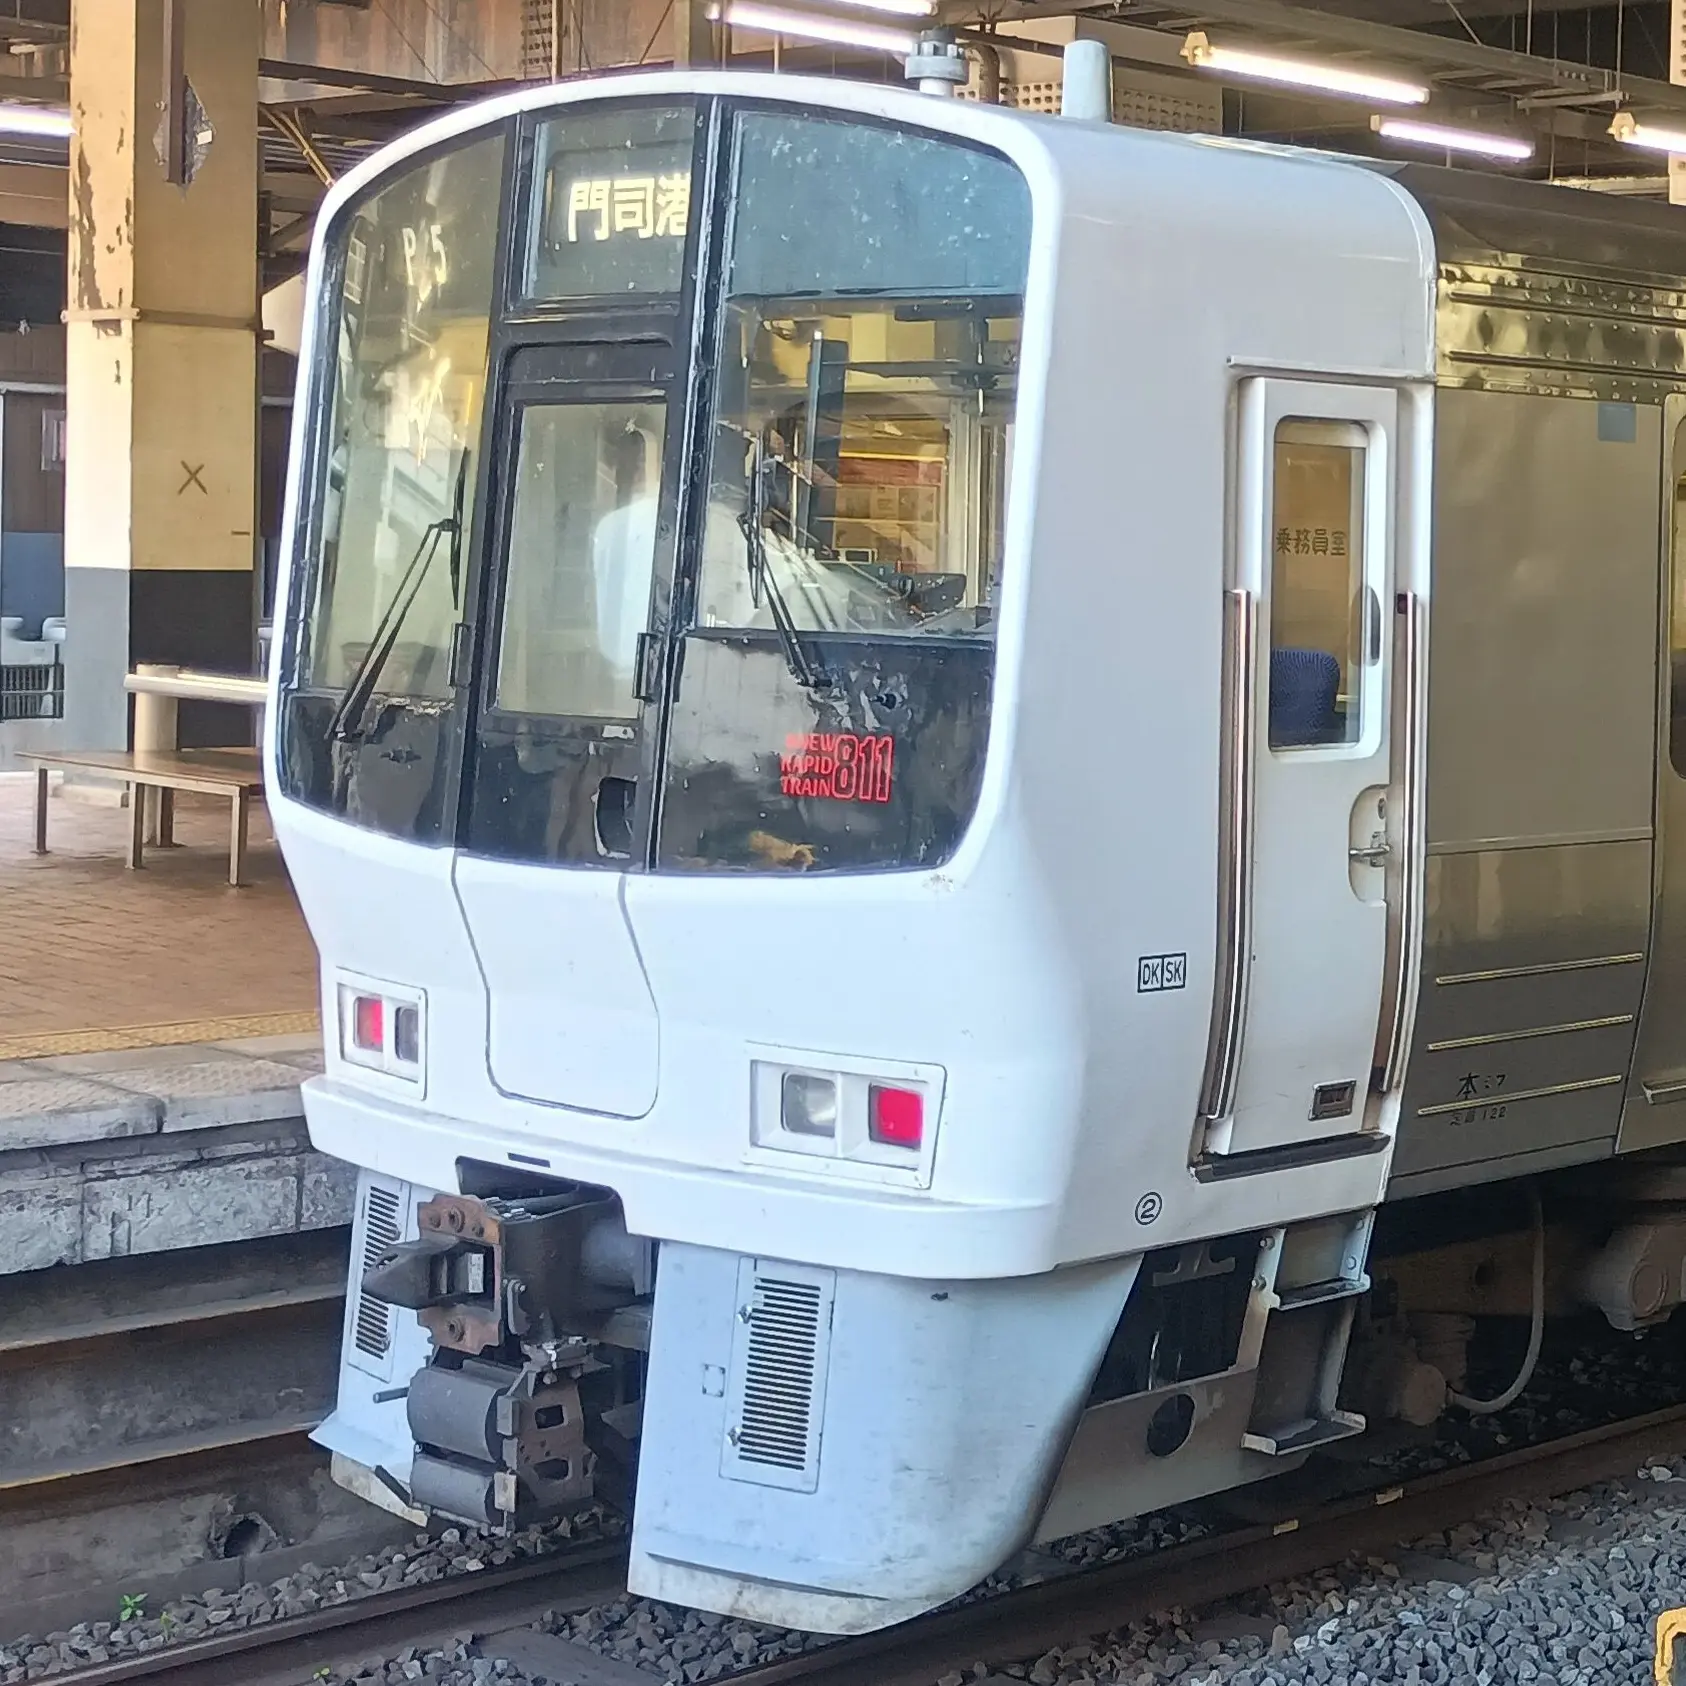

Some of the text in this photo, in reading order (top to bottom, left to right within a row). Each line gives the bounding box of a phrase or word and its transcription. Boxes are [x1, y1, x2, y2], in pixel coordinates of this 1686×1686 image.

[568, 172, 691, 242] 門司港
[1275, 527, 1347, 556] 乗務員室
[781, 754, 834, 775] RAPID
[832, 734, 893, 803] 811
[780, 775, 832, 797] TRAIN
[1142, 959, 1183, 985] DK SK
[1483, 1105, 1507, 1121] 122
